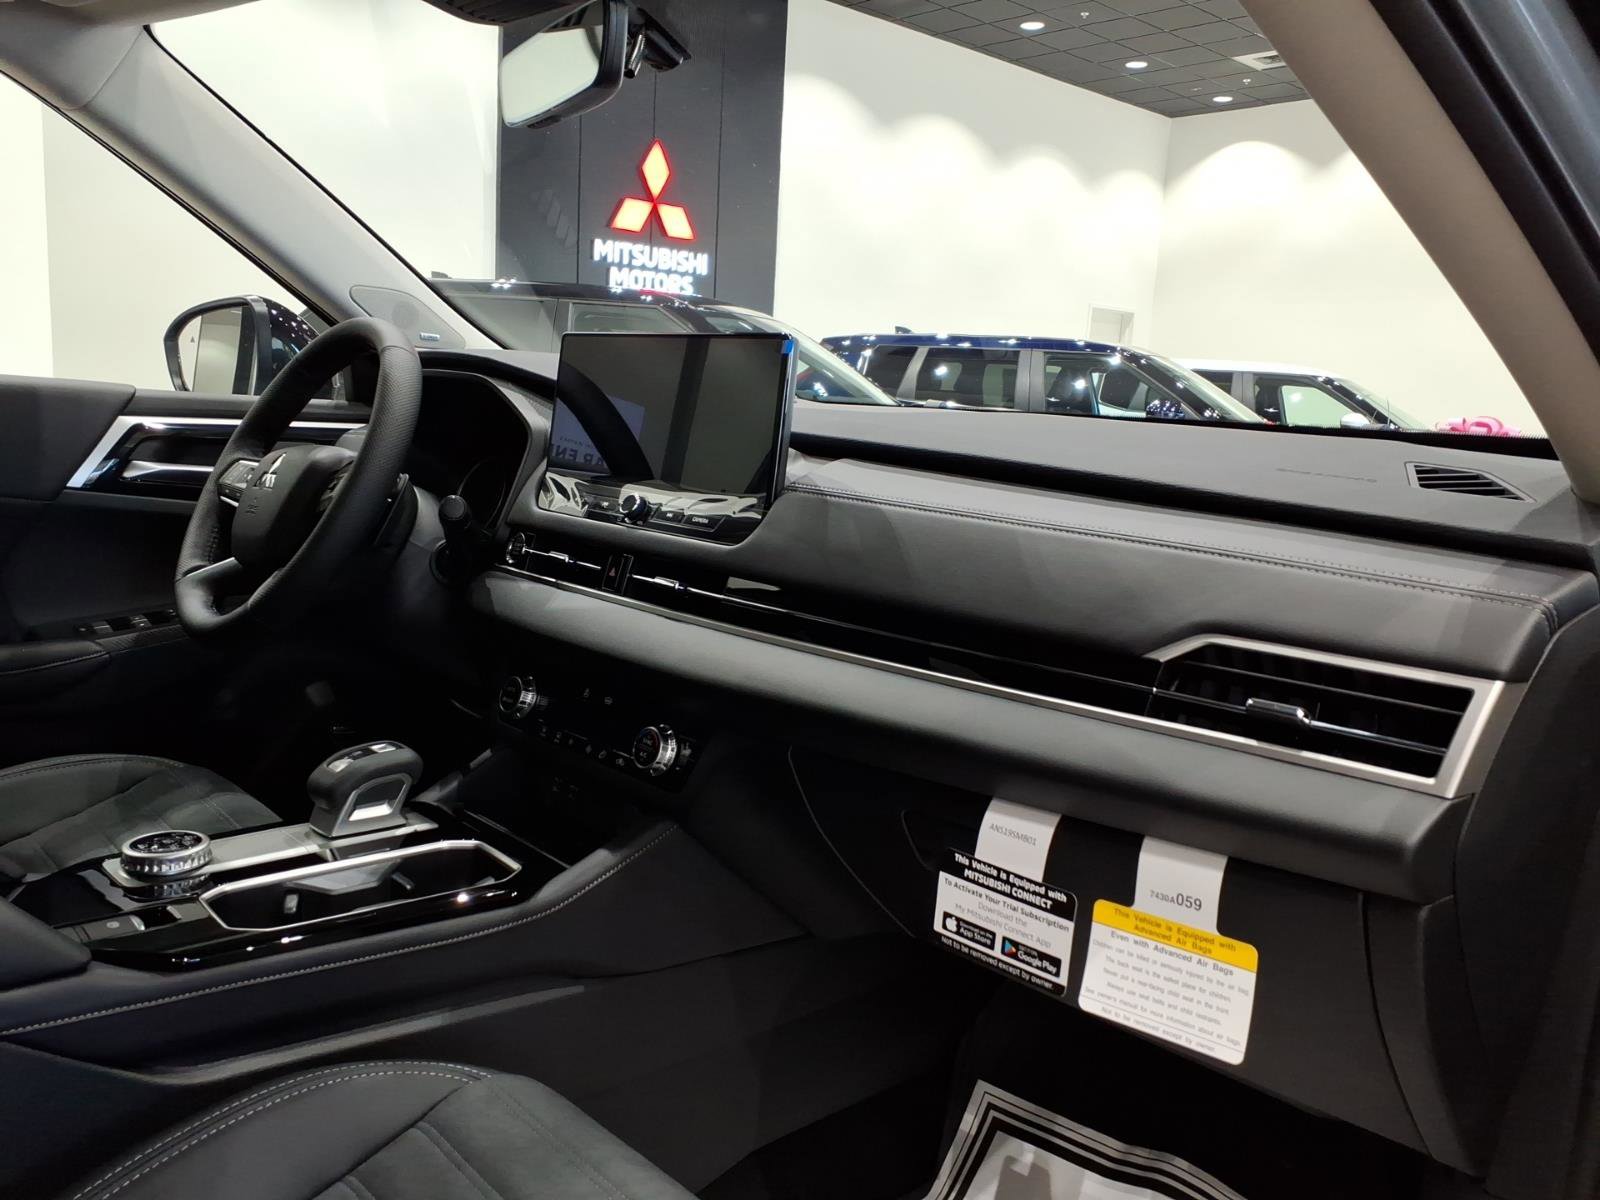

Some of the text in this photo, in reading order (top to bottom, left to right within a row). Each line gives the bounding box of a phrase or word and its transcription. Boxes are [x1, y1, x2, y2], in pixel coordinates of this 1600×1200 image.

[593, 238, 709, 276] MITSUBISHI
[609, 266, 695, 295] MOTORS
[954, 853, 1067, 903] This Vehicle is Equipped with
[963, 868, 1053, 910] MITSUBISHI CONNECT
[943, 877, 1069, 933] To Activate Your Trial Subscription
[959, 926, 973, 938] App
[1114, 908, 1236, 952] This Vehicle is Equipped with
[1134, 925, 1212, 954] Advanced Air Bags
[1016, 949, 1041, 968] Google
[1042, 960, 1057, 974] Play
[1110, 930, 1129, 942] Even
[1132, 938, 1150, 949] with
[1153, 944, 1192, 962] Advanced
[1196, 957, 1208, 967] Air
[1212, 962, 1234, 977] Bags
